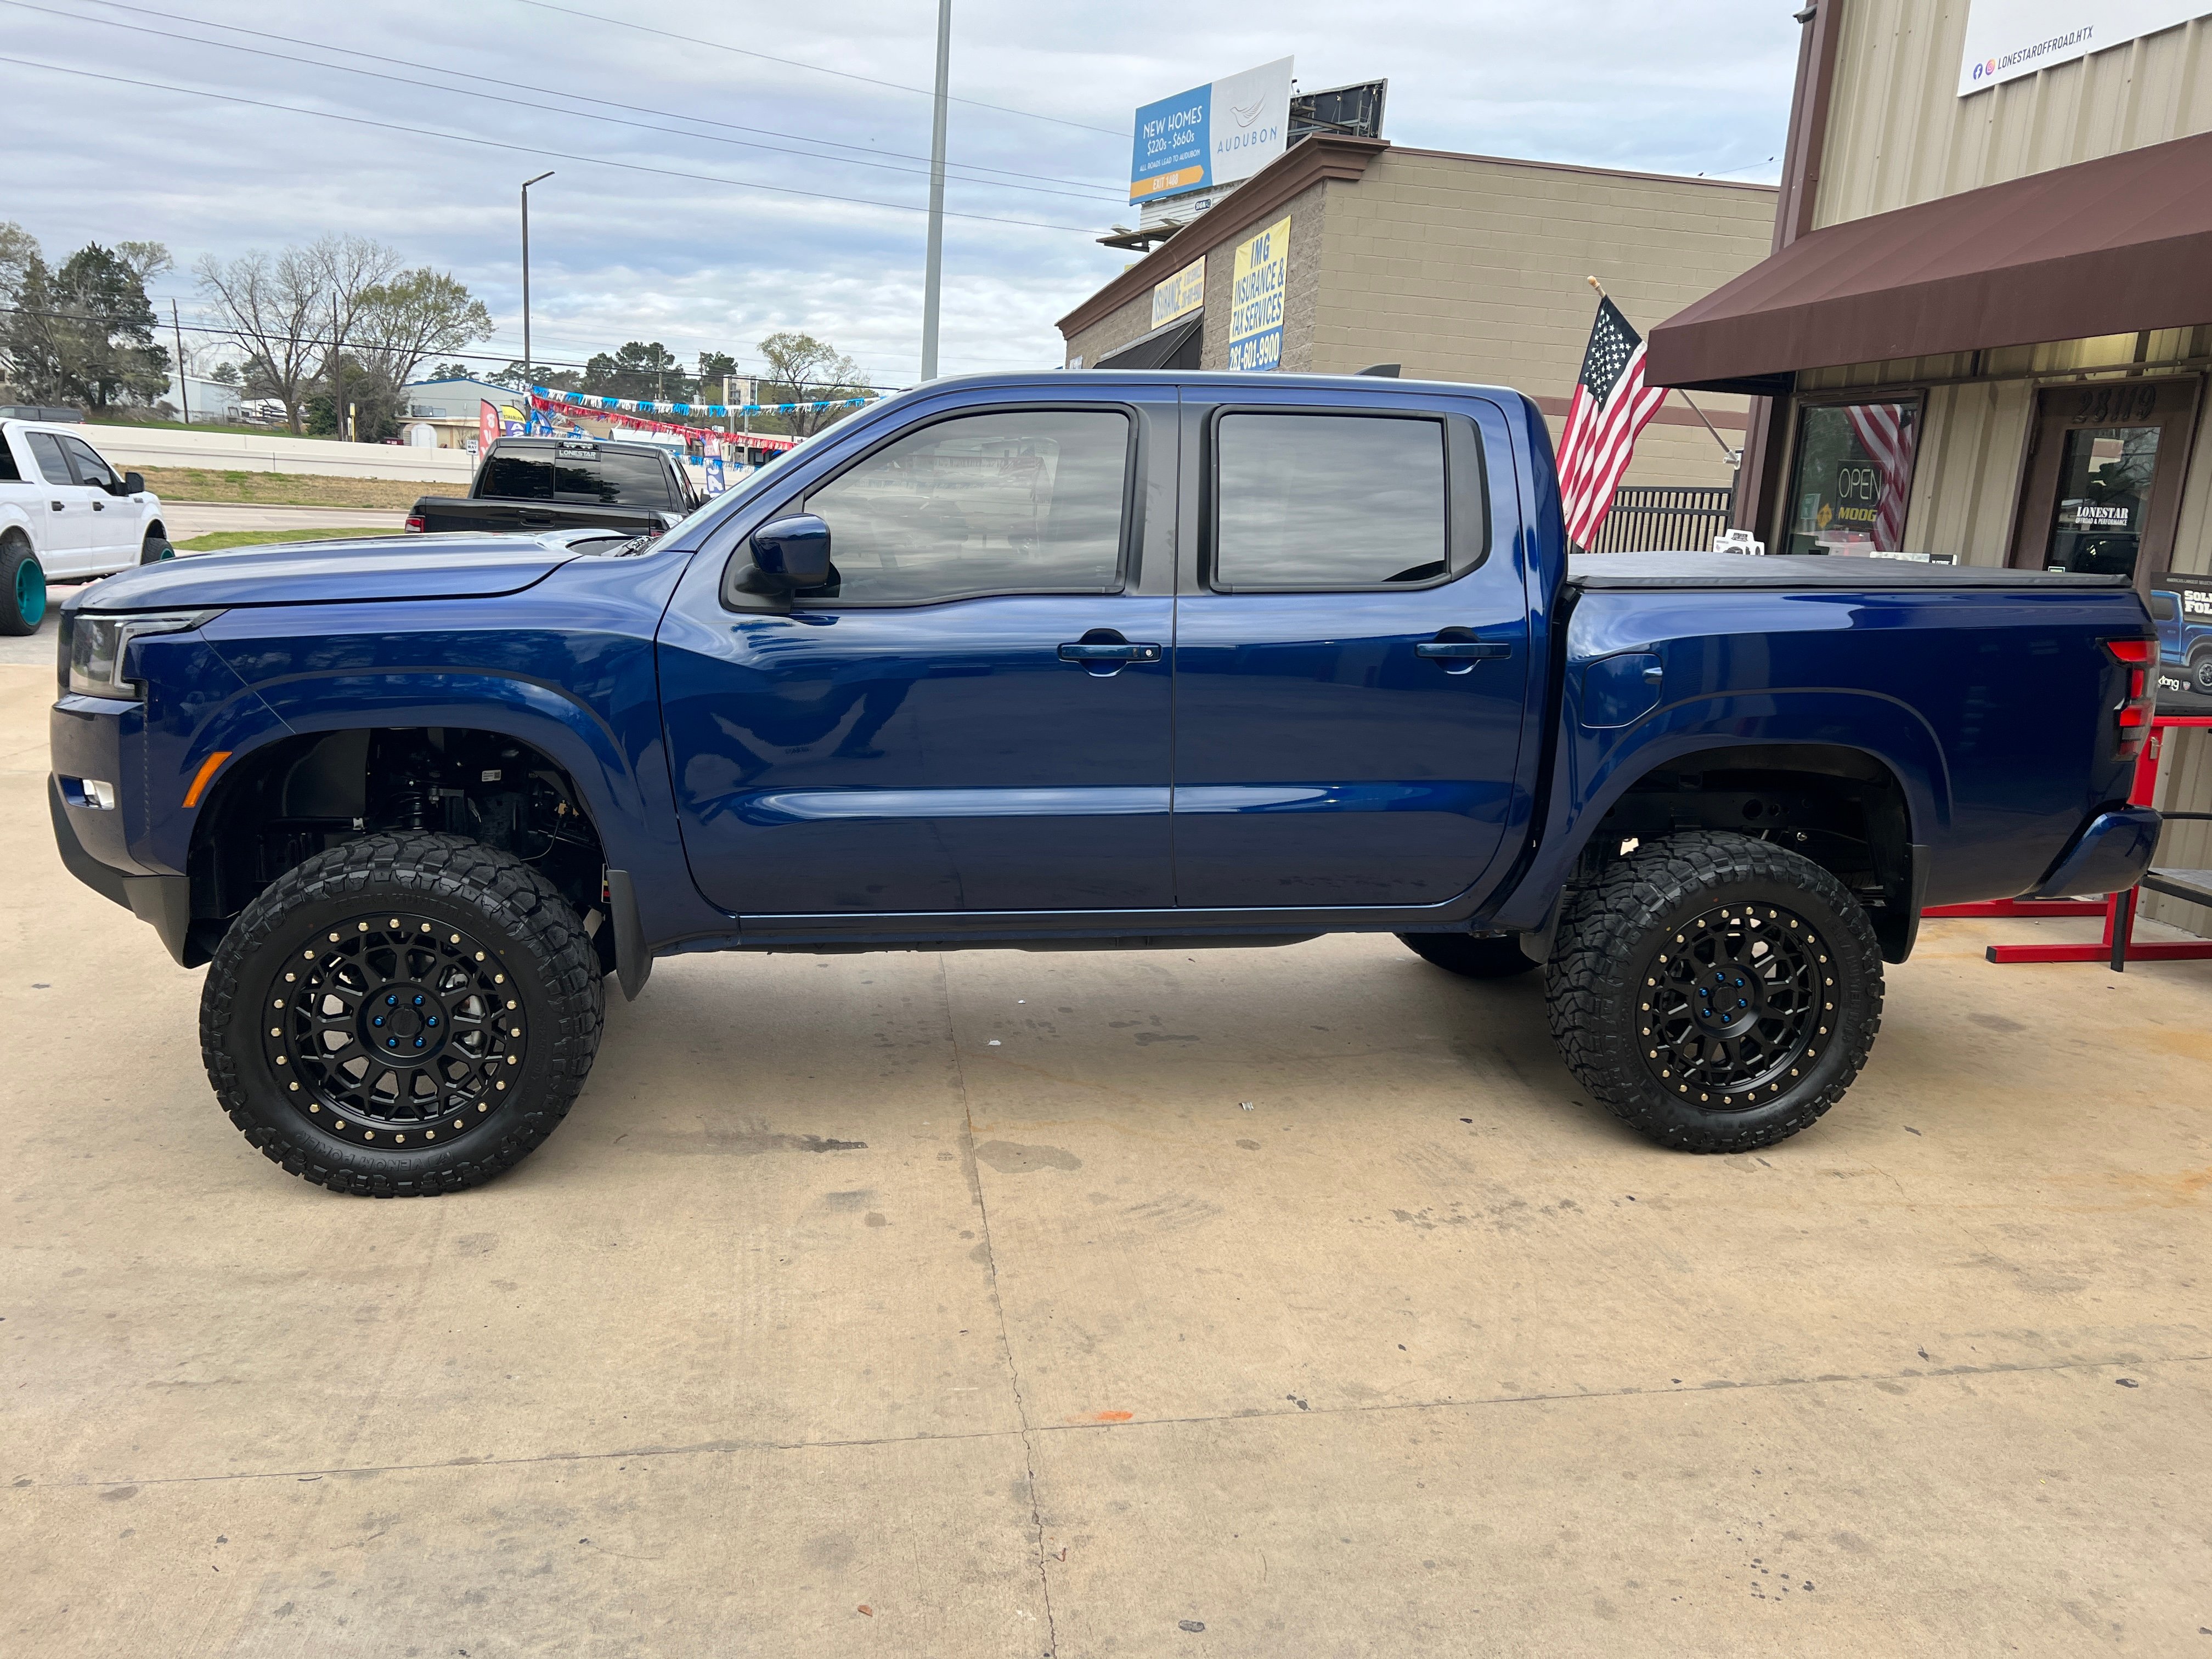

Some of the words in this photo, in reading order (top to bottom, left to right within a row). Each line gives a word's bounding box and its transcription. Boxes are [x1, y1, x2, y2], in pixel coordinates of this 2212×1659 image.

[1997, 25, 2094, 70] LONESTAROFFROAD.HTX
[1143, 117, 1166, 139] NEW
[1167, 105, 1203, 132] HOMES
[1147, 137, 1167, 157] $220s
[1172, 129, 1195, 149] $660s
[1217, 126, 1277, 154] AUDUBON
[1147, 160, 1161, 169] ROADS
[1161, 157, 1172, 166] LEAD
[1173, 155, 1178, 163] TO
[1179, 149, 1200, 161] AUDUBON
[1153, 176, 1165, 190] EXIT
[1166, 173, 1179, 185] 1488
[1250, 232, 1271, 269] IMG
[1234, 261, 1277, 308] INSURANCE
[1277, 257, 1285, 289] &
[1232, 306, 1245, 338] TAX
[1245, 291, 1283, 334] SERVICES
[1229, 331, 1280, 371] 281-601-9900
[2072, 385, 2157, 424] 28119
[558, 449, 596, 458] LONESTAR
[1838, 468, 1882, 500] OPEN
[1838, 506, 1878, 522] MOOG
[2076, 506, 2129, 519] LONESTAR
[296, 1131, 356, 1166] POWER
[359, 1155, 425, 1172] VENOM
